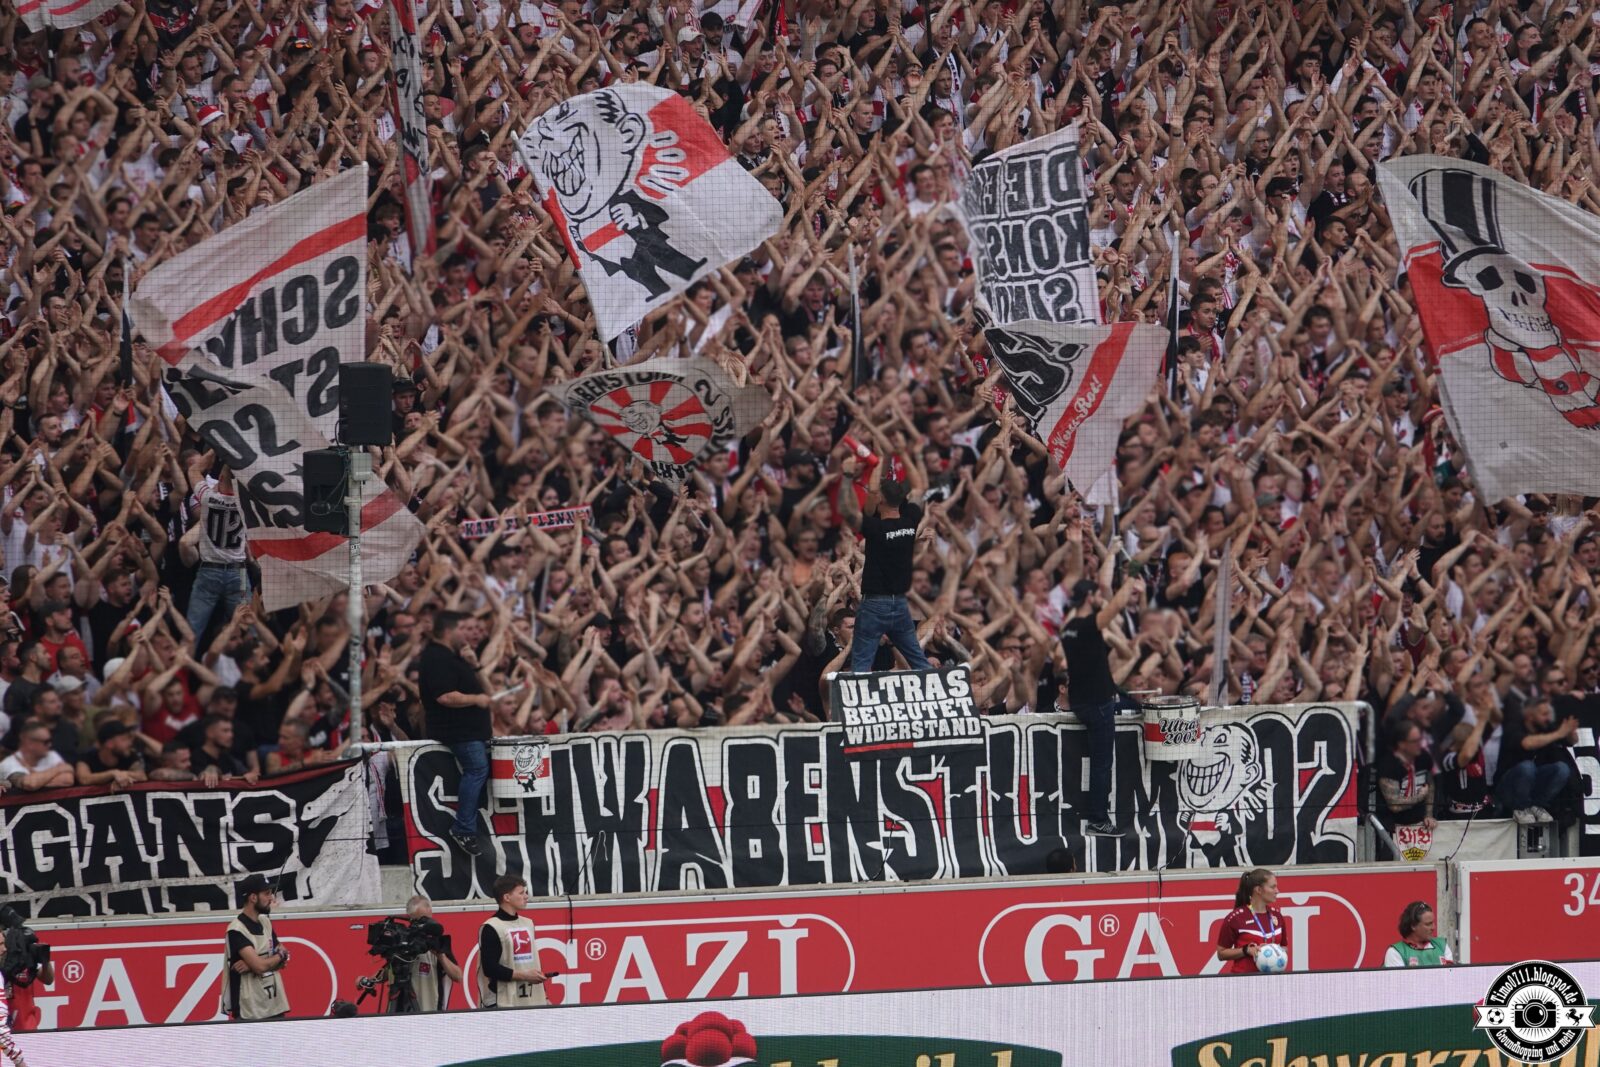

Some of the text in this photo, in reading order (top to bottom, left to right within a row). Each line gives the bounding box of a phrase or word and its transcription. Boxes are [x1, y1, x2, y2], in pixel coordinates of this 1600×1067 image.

[207, 507, 244, 548] 02
[838, 669, 970, 707] ULTRAS
[843, 697, 974, 726] BEDEUTET
[845, 717, 982, 745] WIDERSTAND
[1244, 706, 1356, 868] 02
[0, 788, 298, 896] GANS
